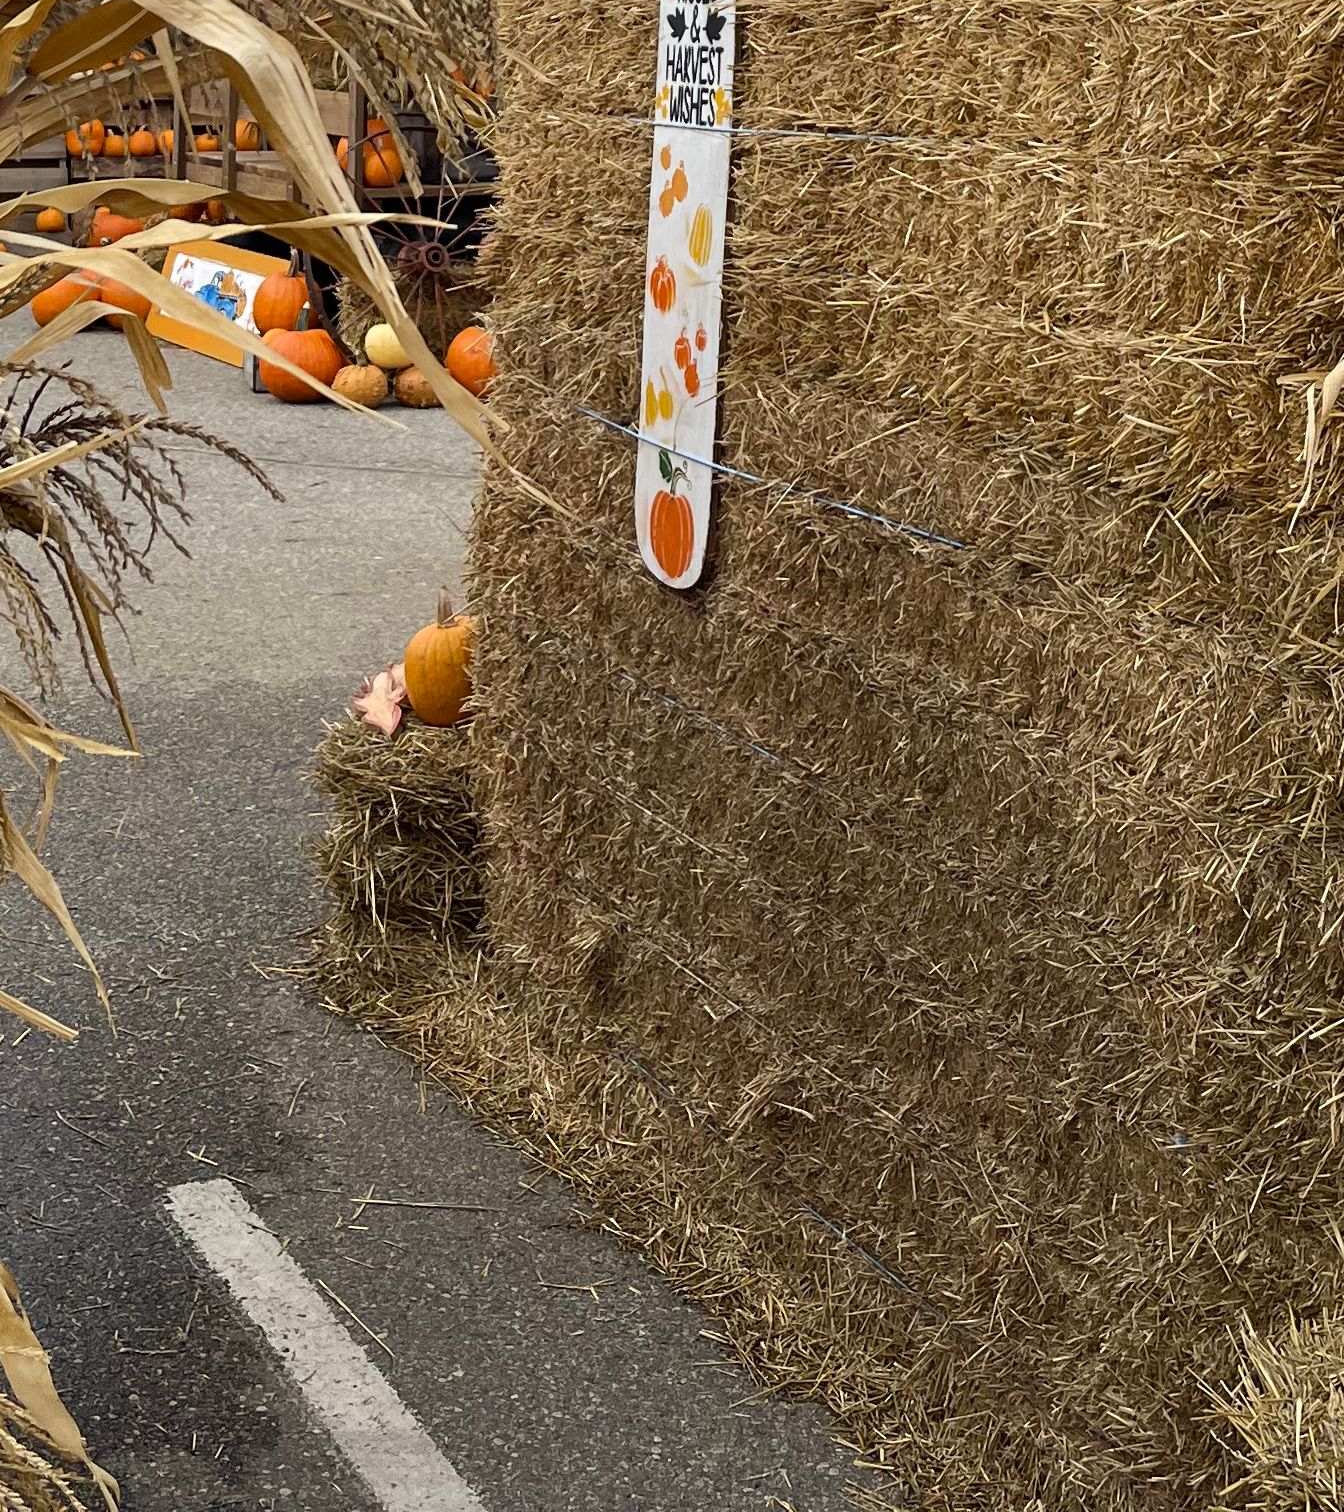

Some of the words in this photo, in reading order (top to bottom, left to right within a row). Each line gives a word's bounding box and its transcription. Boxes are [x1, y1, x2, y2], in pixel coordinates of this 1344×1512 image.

[690, 4, 701, 43] &
[666, 44, 724, 85] HARVEST
[669, 85, 716, 127] WISHES
